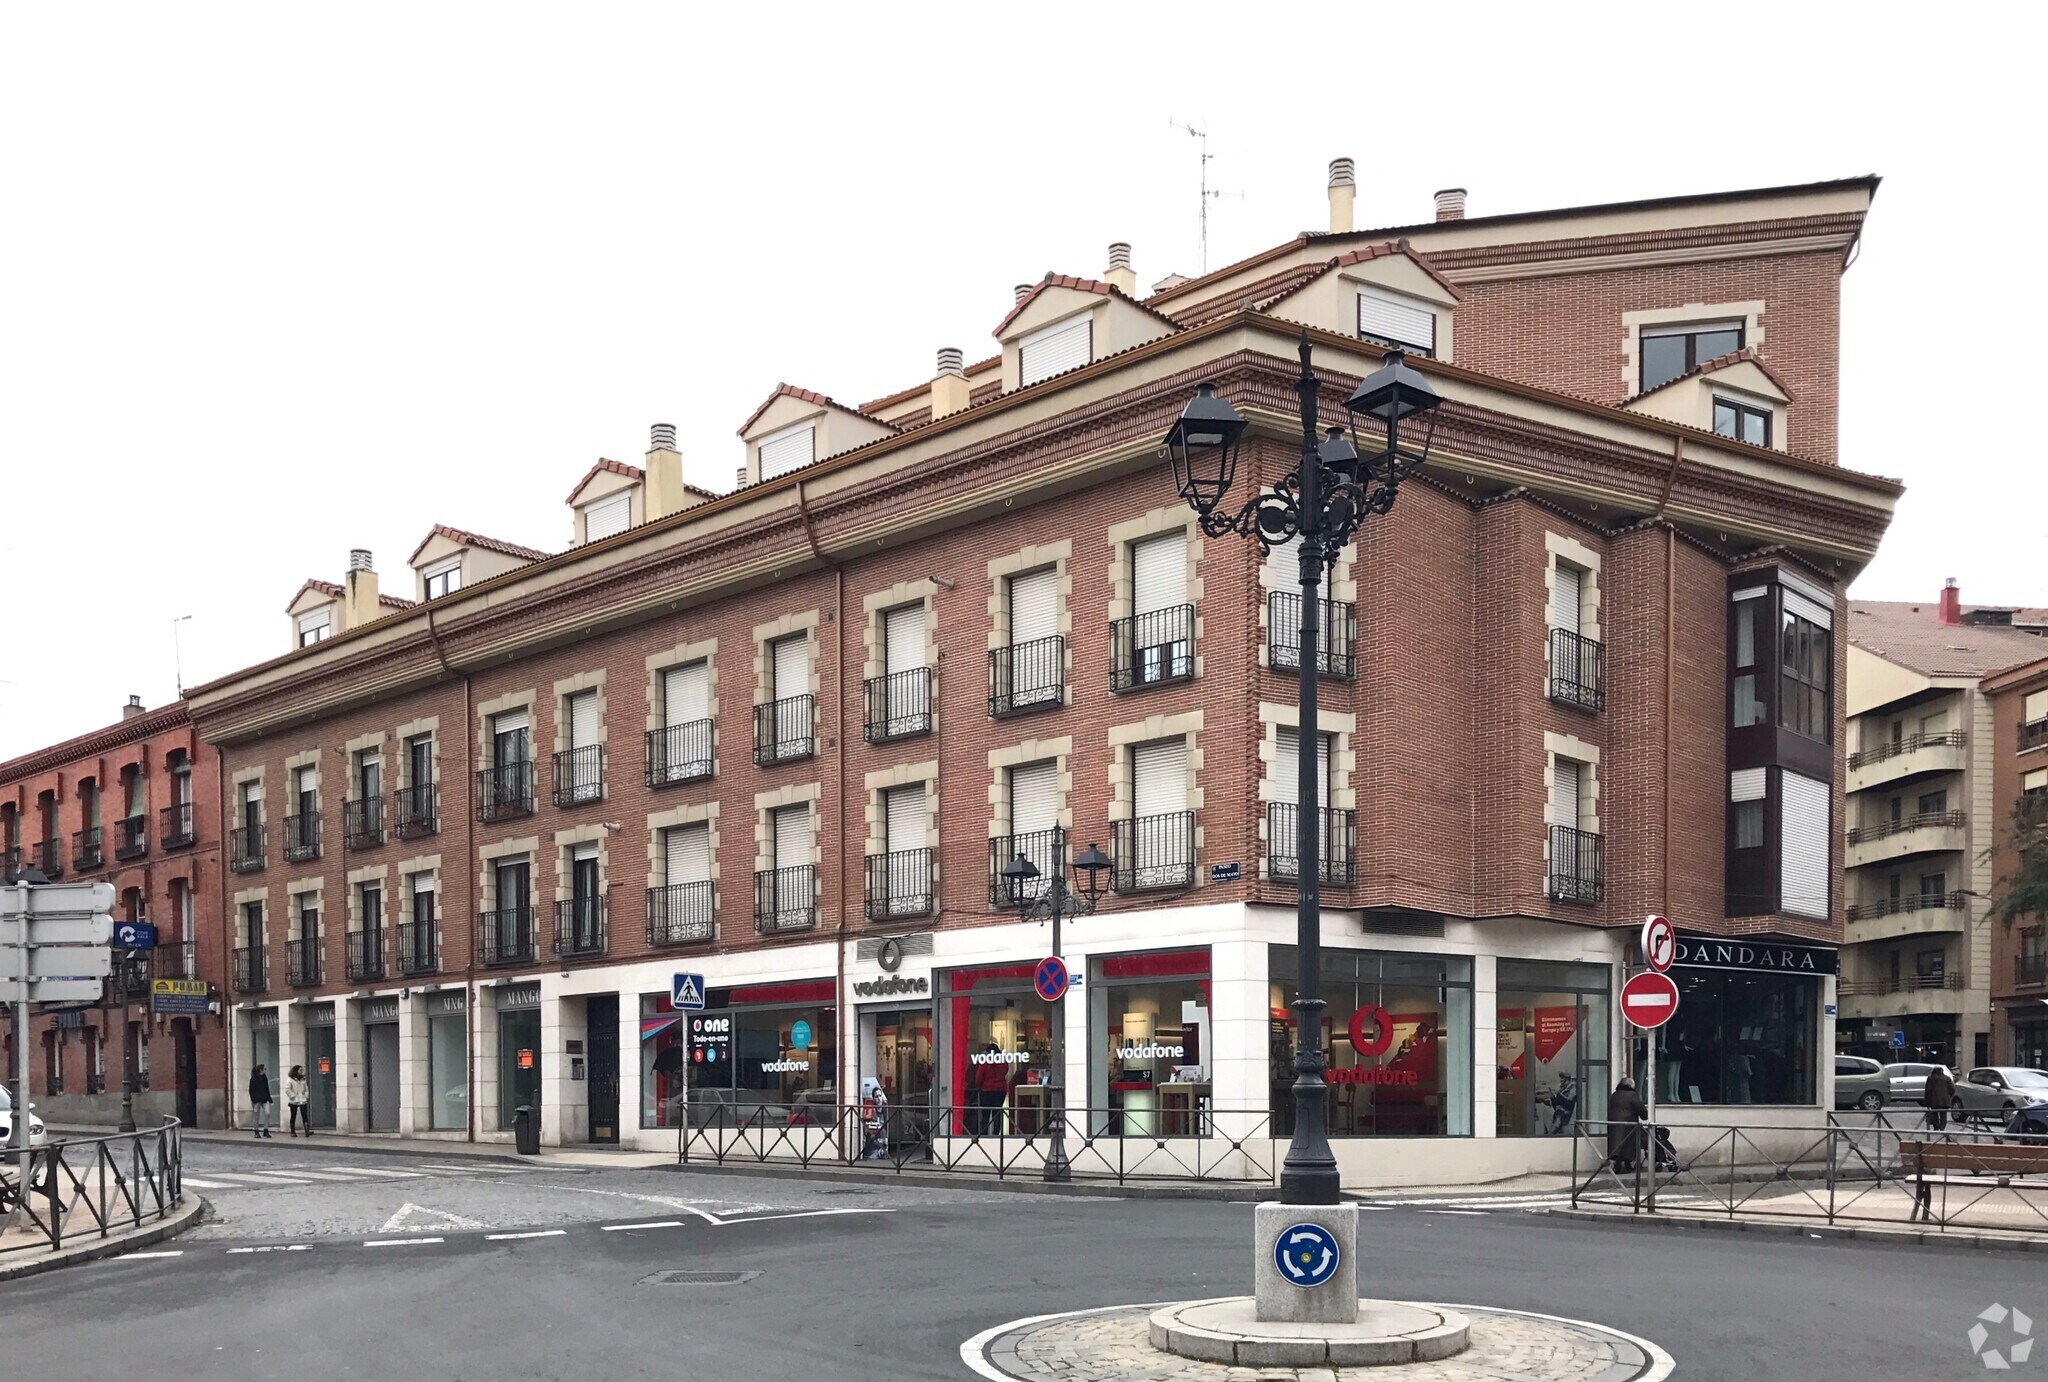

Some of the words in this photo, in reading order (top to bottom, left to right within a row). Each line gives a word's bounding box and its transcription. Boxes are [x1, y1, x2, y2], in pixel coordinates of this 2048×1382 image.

[1673, 943, 1816, 969] DANDARA
[853, 974, 928, 997] vodafone
[443, 997, 464, 1012] MNG
[317, 1008, 336, 1022] MNG
[704, 1018, 730, 1033] one
[693, 1034, 729, 1043] Todo-en-uno
[970, 1048, 1030, 1065] vodafone
[1116, 1042, 1185, 1059] vodafone
[761, 1058, 810, 1073] vodafone
[1323, 1064, 1418, 1085] vodafone
